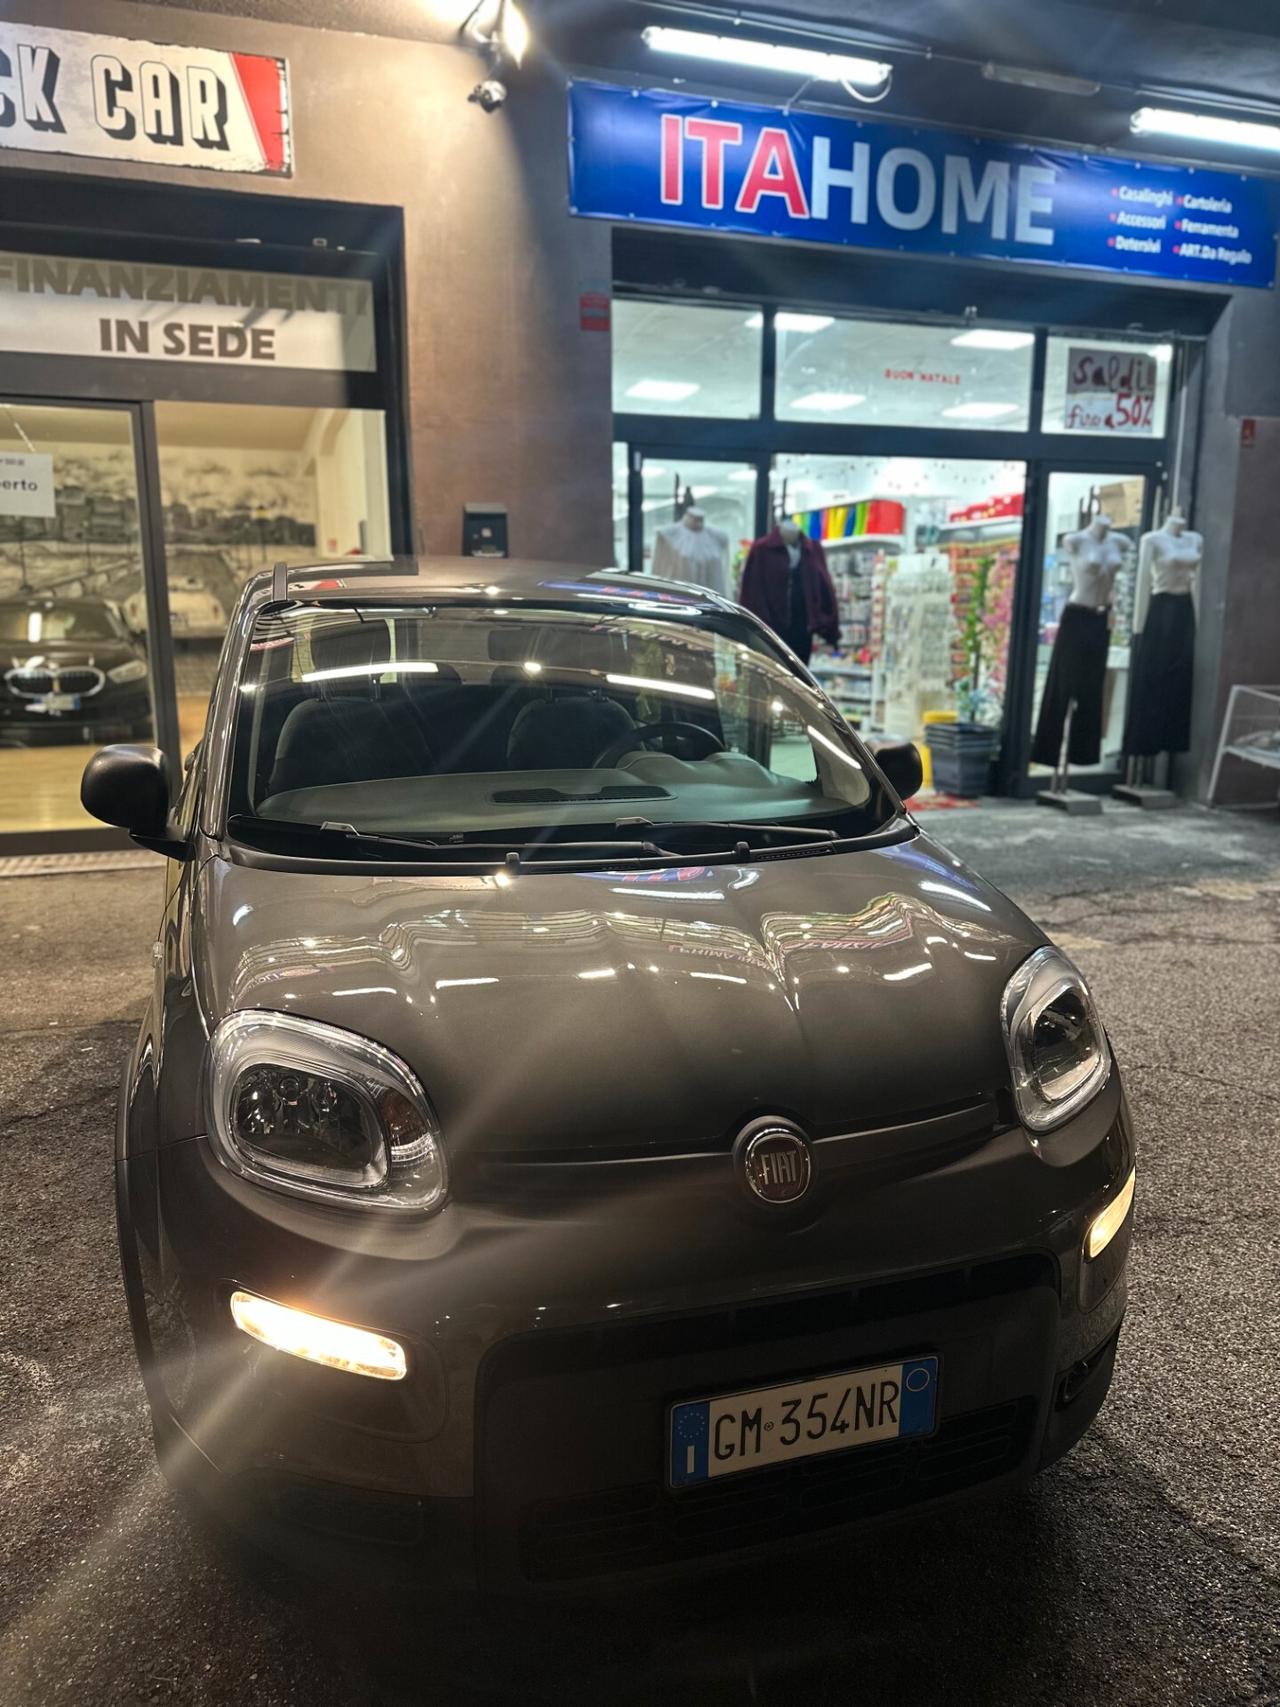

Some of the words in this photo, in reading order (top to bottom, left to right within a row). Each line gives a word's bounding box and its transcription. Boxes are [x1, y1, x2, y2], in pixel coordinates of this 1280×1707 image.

[90, 53, 231, 152] CAR
[660, 113, 1056, 246] ITAHOME
[1118, 185, 1173, 208] Casalinghi
[1183, 194, 1233, 214] Cartoleria
[1116, 211, 1168, 230] Accessori
[1115, 235, 1162, 254] Detersivi
[99, 317, 149, 353] IN
[162, 322, 276, 361] SEDE
[0, 479, 38, 492] erto
[760, 1150, 797, 1185] FIAT
[713, 1407, 762, 1461] GM
[780, 1379, 900, 1446] 354NR
